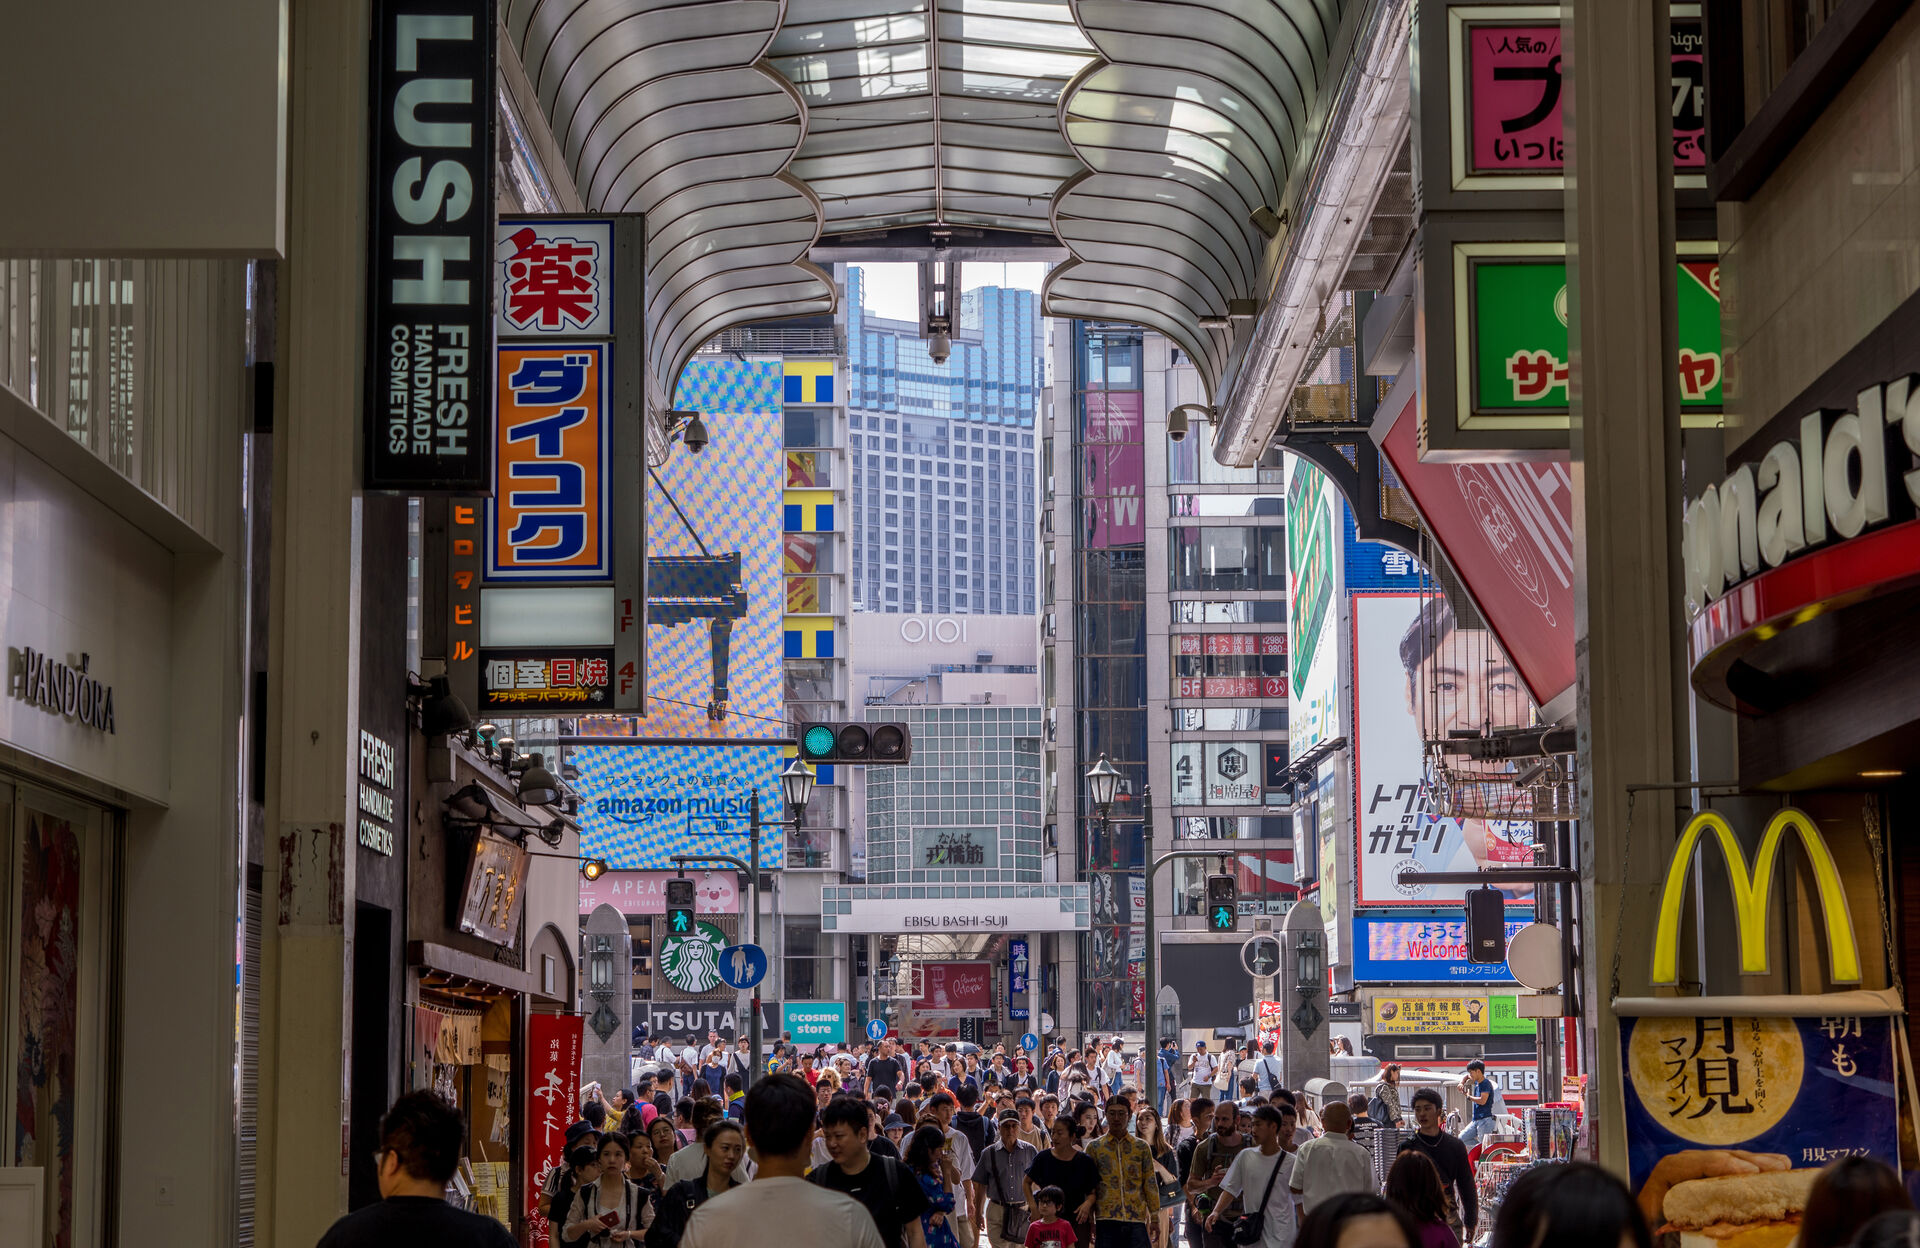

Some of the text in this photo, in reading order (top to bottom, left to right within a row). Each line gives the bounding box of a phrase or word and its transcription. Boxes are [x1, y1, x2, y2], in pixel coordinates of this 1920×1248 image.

[1497, 35, 1548, 55] 人気の
[392, 14, 474, 305] LUSH
[509, 243, 593, 326] 薬
[389, 324, 411, 456] COSMETICS
[412, 324, 433, 455] HANDMADE
[436, 325, 470, 456] FRESH
[507, 353, 592, 564] ダイコク
[452, 505, 476, 662] ヒロタビル
[1208, 636, 1254, 645] 食べ放題
[1208, 645, 1254, 654] 飲み放題
[485, 658, 608, 690] 個室日焼
[24, 646, 116, 735] PANDORA
[1182, 680, 1201, 696] 5F
[359, 728, 394, 790] FRESH
[359, 783, 394, 824] HANDMADE
[597, 797, 682, 815] amazon
[715, 820, 729, 831] HD
[359, 819, 394, 857] COSMETICS
[938, 832, 972, 845] なんば
[1368, 824, 1448, 854] ガセリ
[926, 845, 984, 865] 戎橋筋
[904, 916, 940, 927] EBISU
[1407, 940, 1467, 958] Welcome
[1449, 965, 1507, 975] 雪印メグミルク
[1402, 1001, 1461, 1012] 店舗情報館
[788, 1013, 840, 1023] @cosme
[797, 1024, 832, 1034] store
[1660, 1036, 1691, 1118] マフィン
[1802, 1147, 1870, 1162] 月見マフィン
